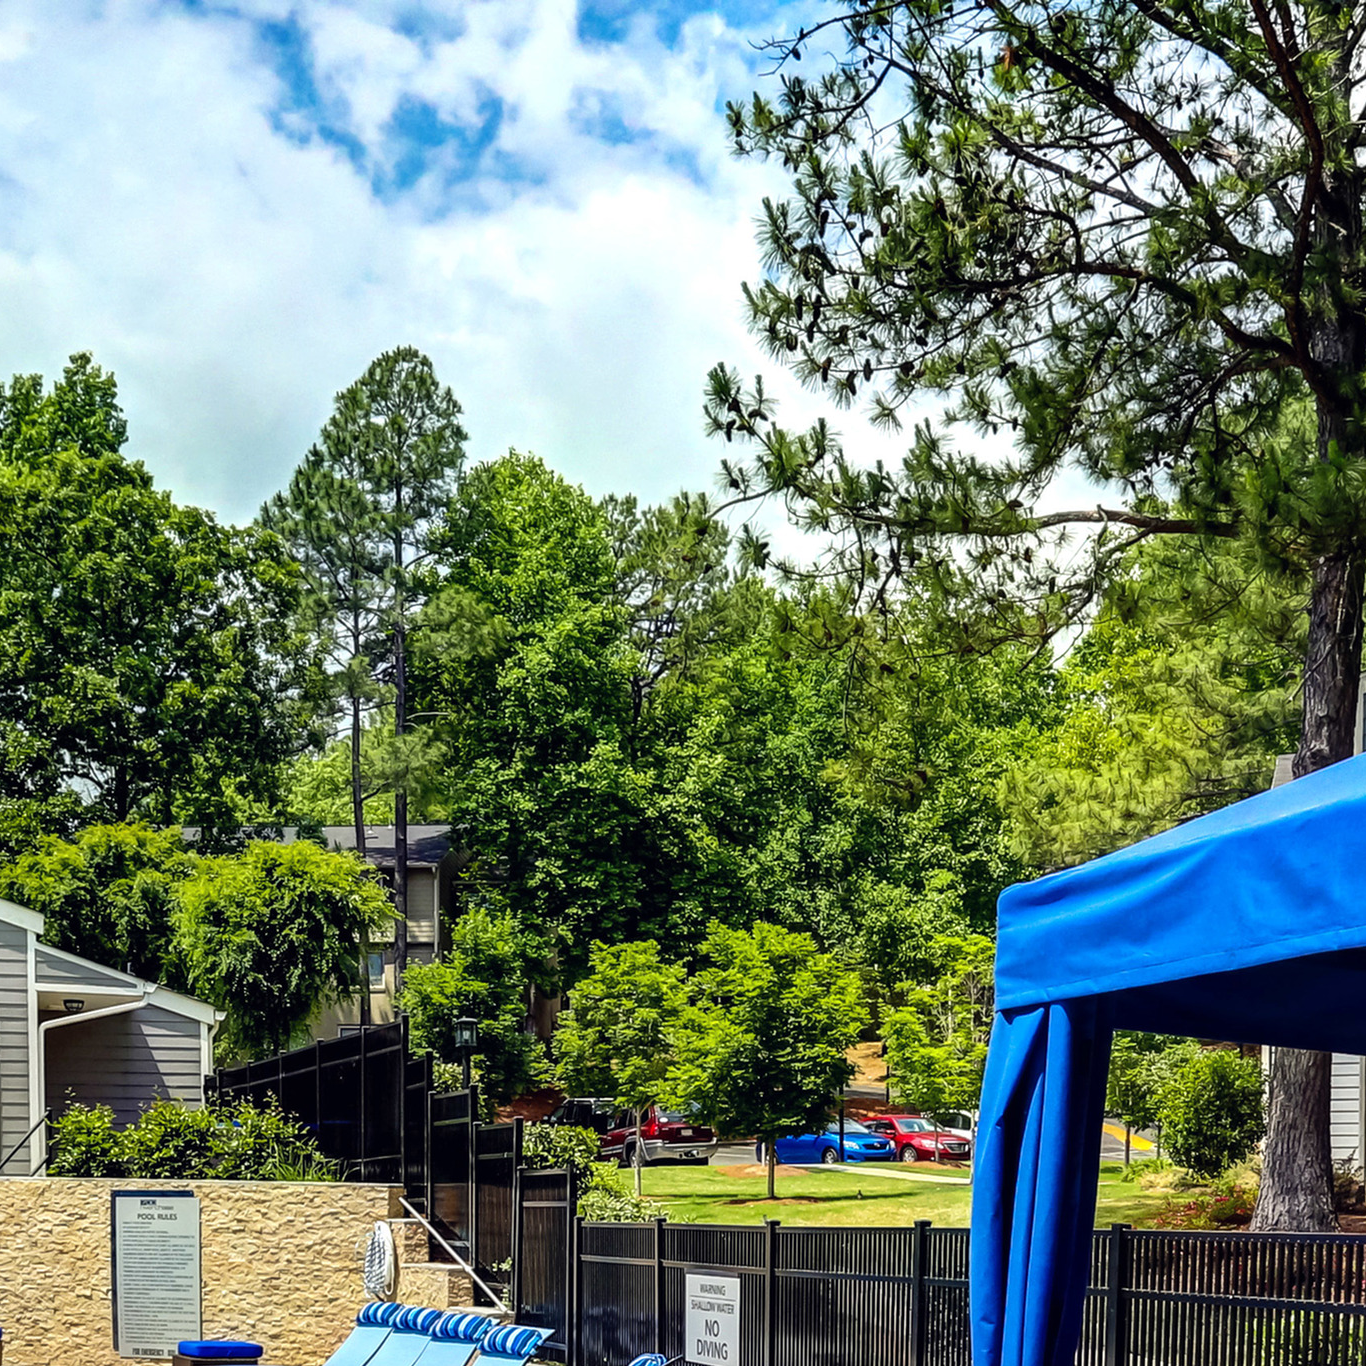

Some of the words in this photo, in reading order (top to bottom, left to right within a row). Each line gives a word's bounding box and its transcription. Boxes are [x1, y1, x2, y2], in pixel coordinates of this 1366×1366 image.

[699, 1283, 726, 1296] WARNING
[691, 1300, 716, 1312] SHALLOW
[716, 1303, 735, 1315] WATER
[704, 1319, 720, 1337] NO
[696, 1339, 728, 1360] DIVING
